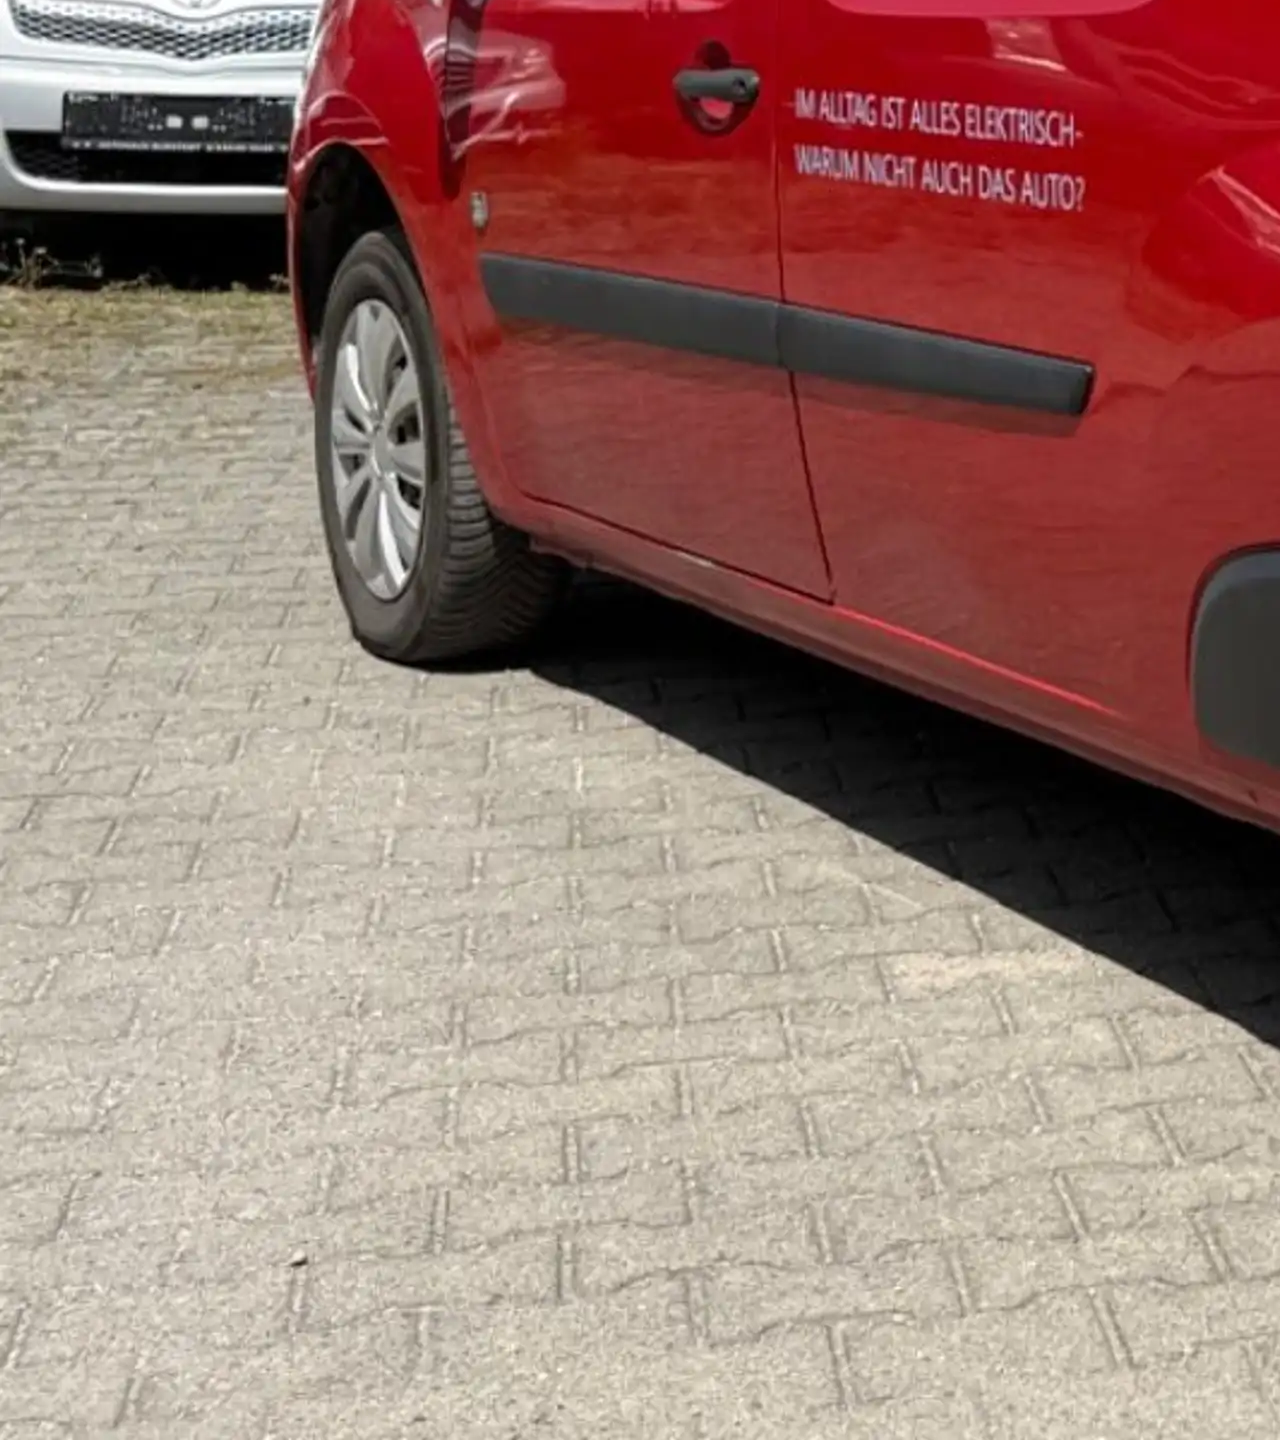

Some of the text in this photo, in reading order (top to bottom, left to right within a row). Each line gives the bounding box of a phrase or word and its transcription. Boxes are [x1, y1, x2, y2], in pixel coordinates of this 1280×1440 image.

[793, 87, 815, 119] IM
[819, 90, 876, 127] ALLTAG
[881, 96, 907, 130] IST
[909, 98, 962, 137] ALLES
[793, 143, 1087, 212] WARUM NICHT AUCH DAS AUTO?
